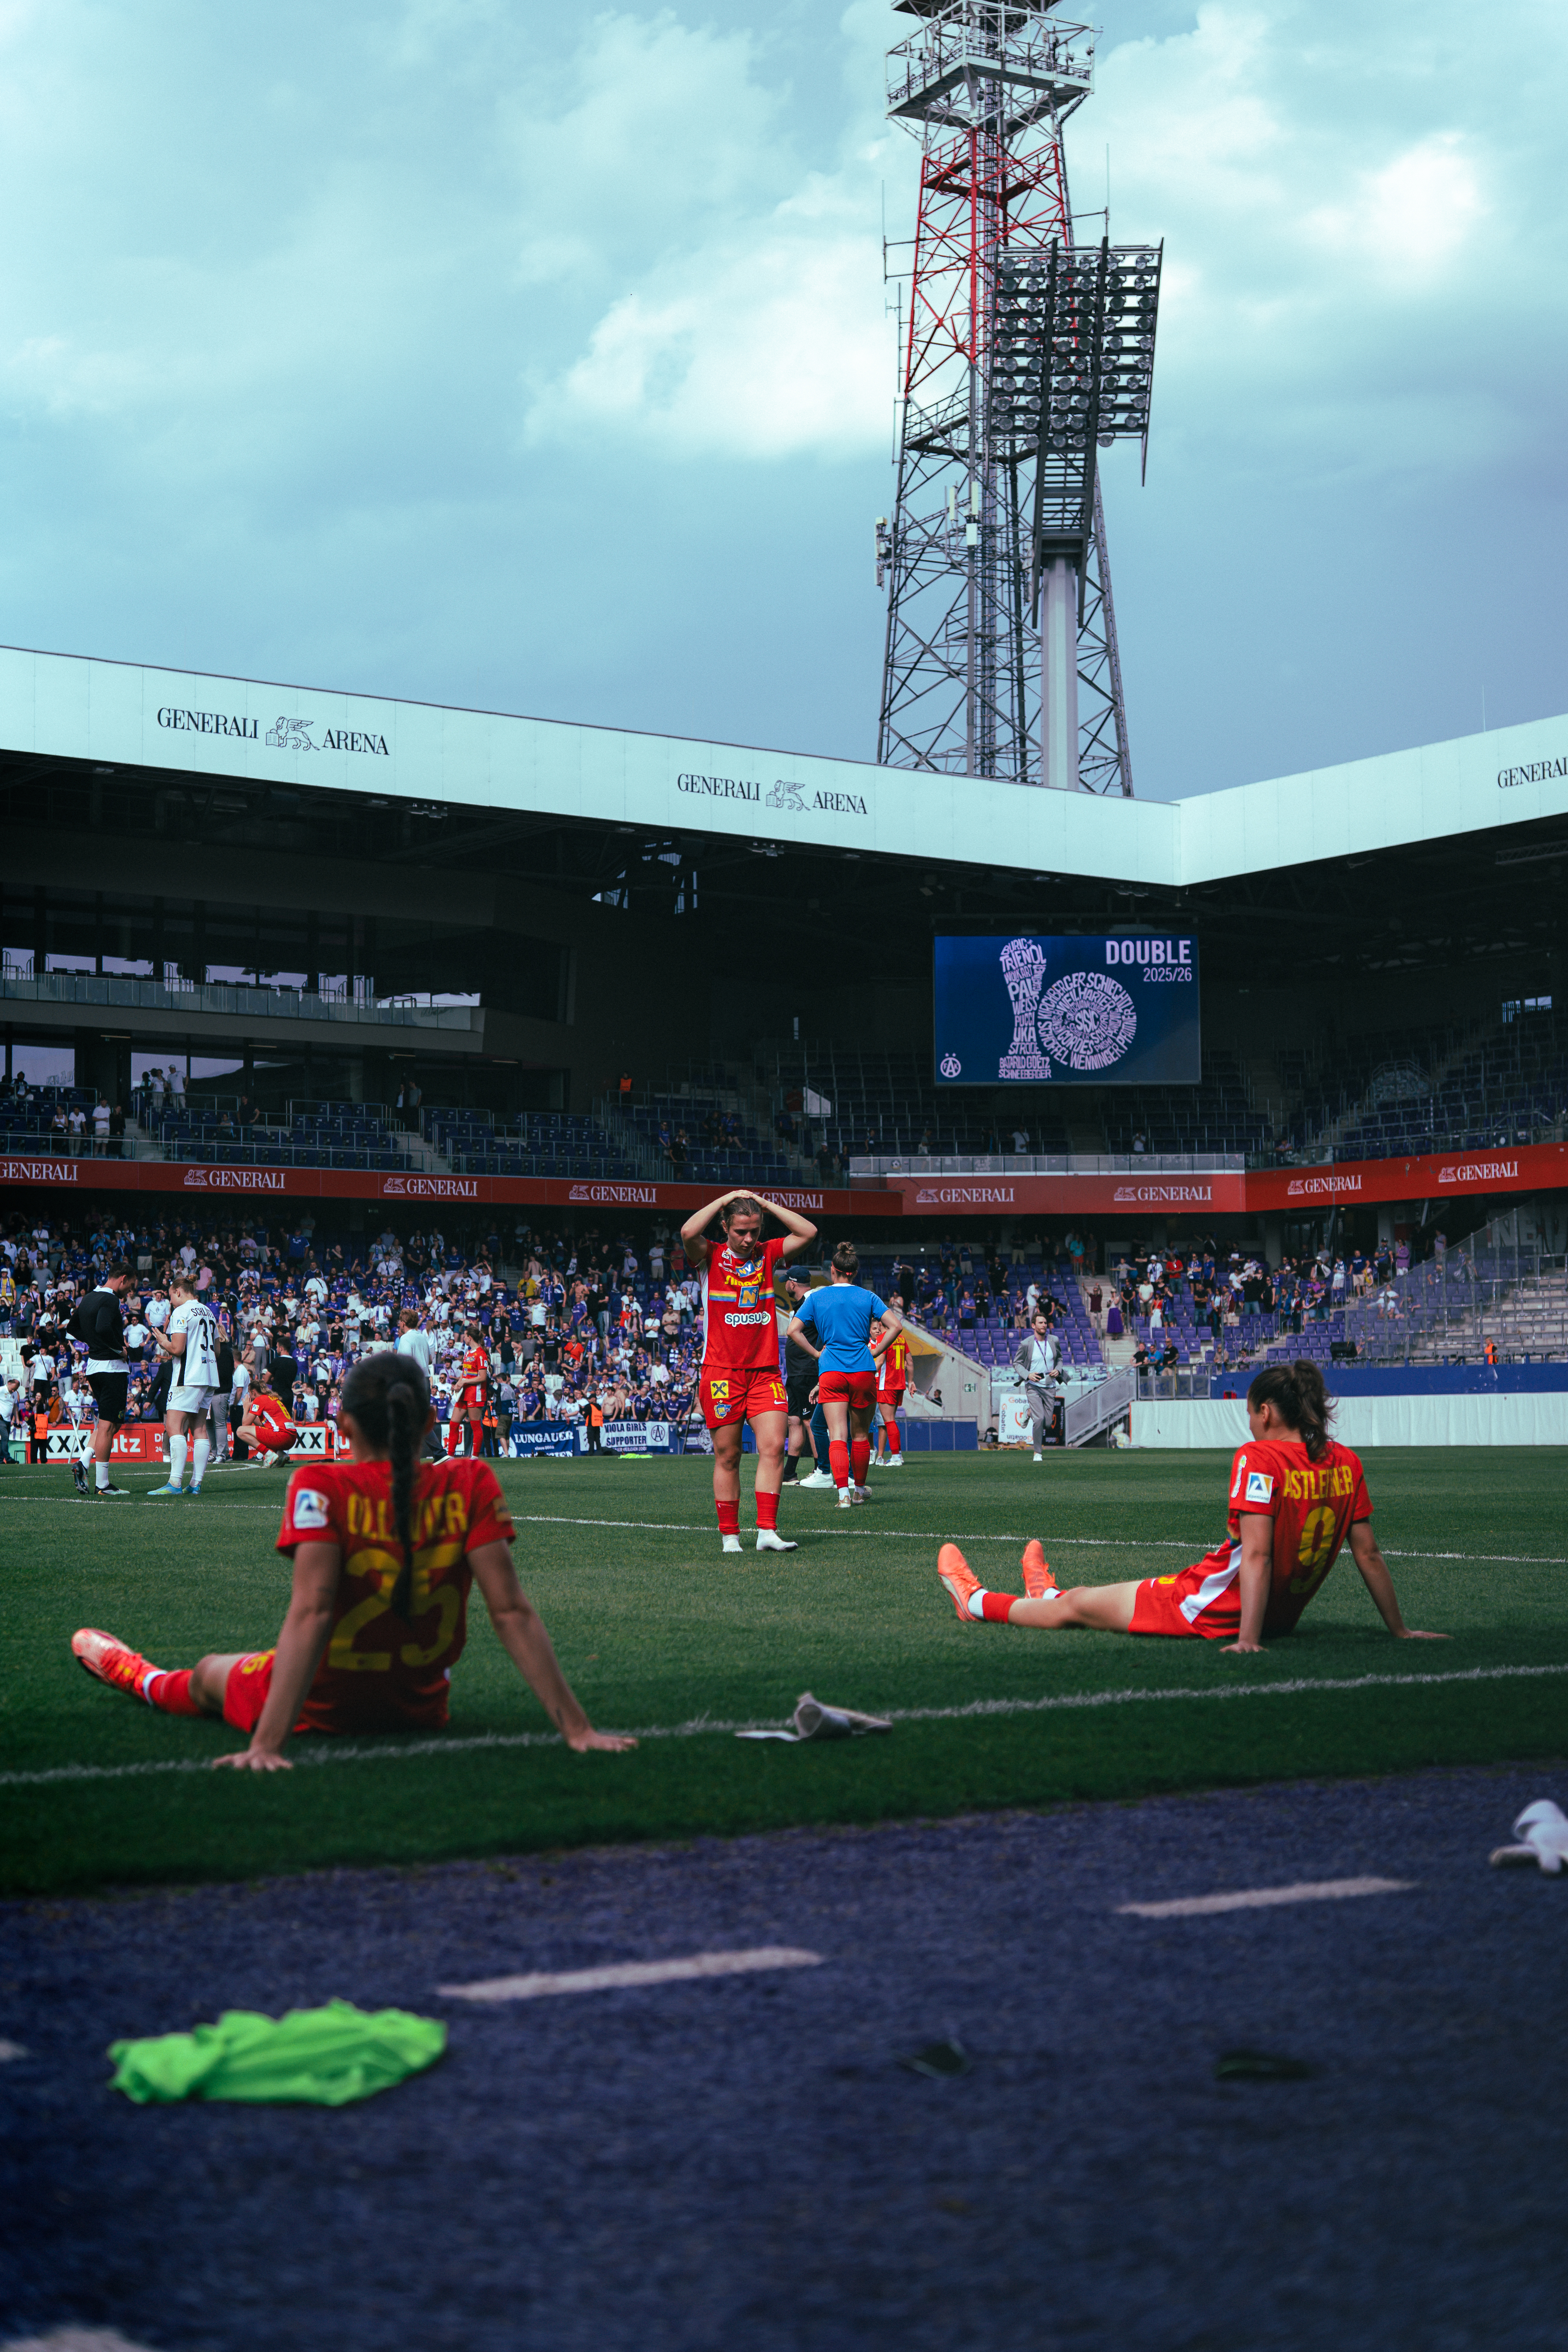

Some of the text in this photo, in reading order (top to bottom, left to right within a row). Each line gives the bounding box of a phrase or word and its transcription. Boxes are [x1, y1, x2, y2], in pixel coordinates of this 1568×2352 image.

[157, 708, 389, 755] GENERALI ARENA
[677, 773, 868, 814] GENERALI ARENA
[1106, 940, 1192, 964] DOUBLE
[1143, 967, 1192, 982] 2025/26
[1007, 978, 1039, 1001] PAL
[1012, 995, 1039, 1015] WEISS
[1015, 1011, 1035, 1027] PUCCI
[1013, 1027, 1036, 1042] UKA
[1057, 1030, 1094, 1054] CORDES
[0, 1162, 78, 1181] GENERALI
[1457, 1161, 1519, 1181] GENERALI
[209, 1171, 285, 1189] GENERALI
[407, 1179, 477, 1196] GENERALI
[1305, 1175, 1362, 1194] GENERALI
[590, 1185, 657, 1203] GENERALI
[762, 1192, 823, 1209] GENERALI
[940, 1187, 1015, 1202] GENERALI
[1138, 1185, 1212, 1201] GENERALI
[739, 1264, 751, 1274] NV
[742, 1290, 756, 1304] N
[726, 1314, 761, 1325] spusu
[769, 1383, 785, 1399] 15
[604, 1423, 647, 1433] VIOLA GIRLS
[514, 1431, 574, 1443] LUNGAUER
[606, 1436, 646, 1446] SUPPORTER
[1283, 1466, 1354, 1500] ASTLEITNER
[1290, 1506, 1336, 1594] 9
[327, 1543, 463, 1671] 25
